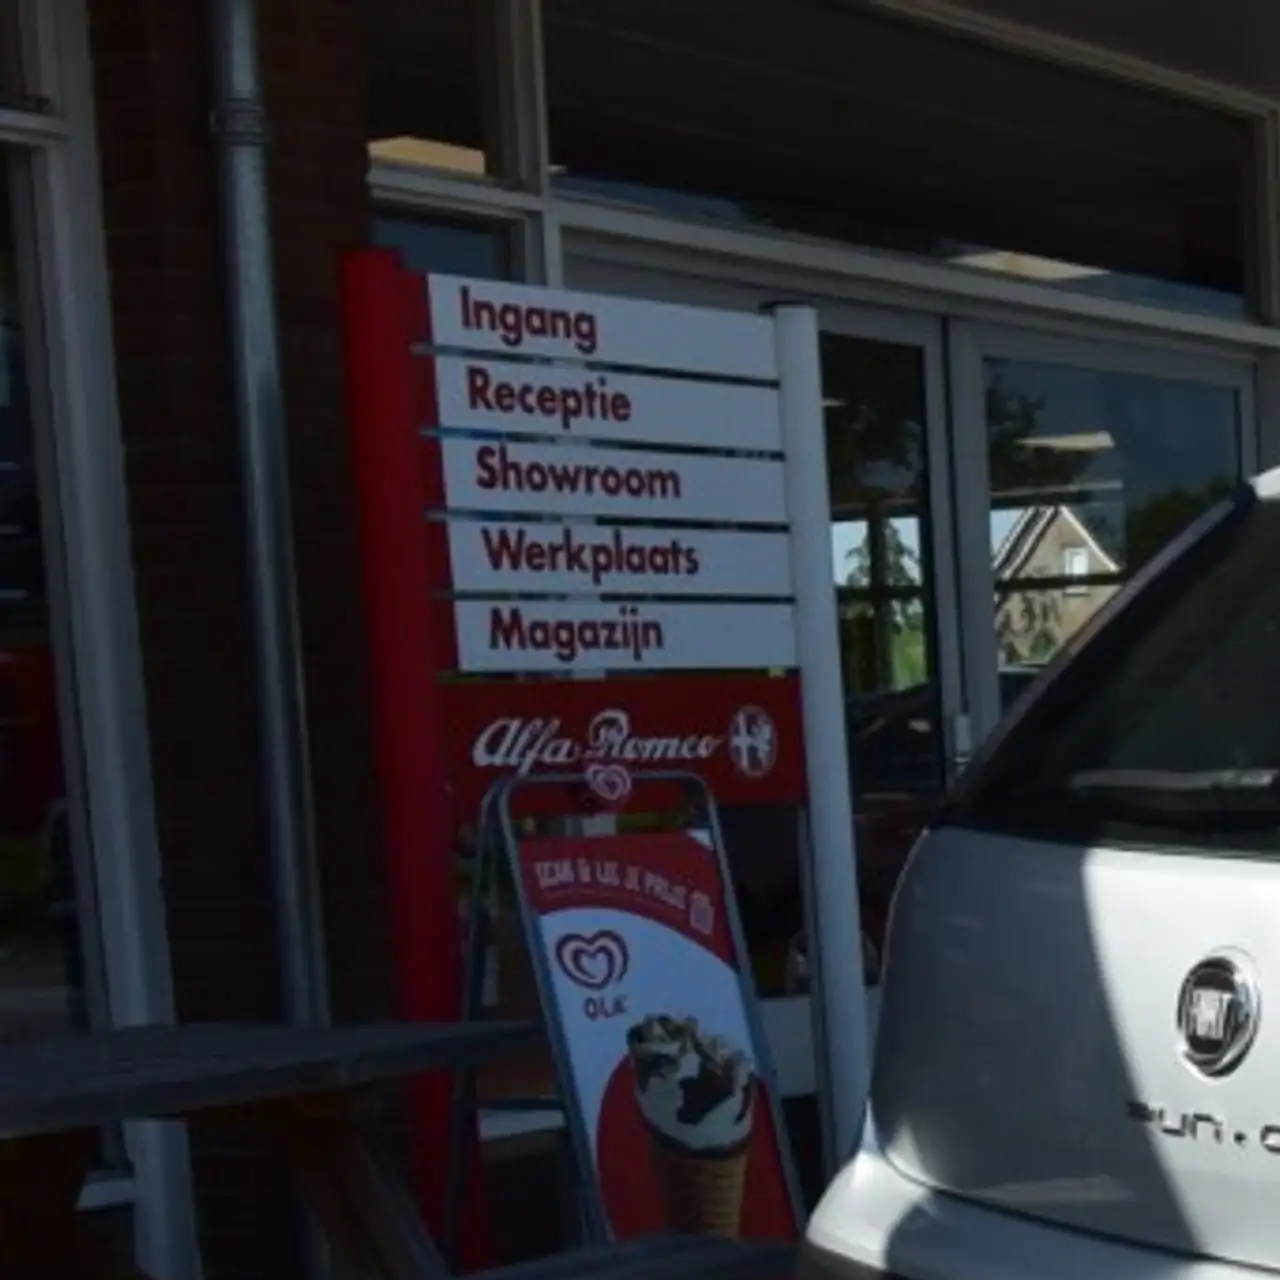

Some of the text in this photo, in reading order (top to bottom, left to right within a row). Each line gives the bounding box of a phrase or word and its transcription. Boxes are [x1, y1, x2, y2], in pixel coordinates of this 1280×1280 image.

[460, 286, 598, 356] Ingang
[468, 366, 632, 430] Receptie
[477, 445, 681, 499] Showroom
[482, 528, 700, 584] Werkplaats
[489, 607, 664, 662] Magazijn
[472, 708, 724, 775] Alfa Romeo
